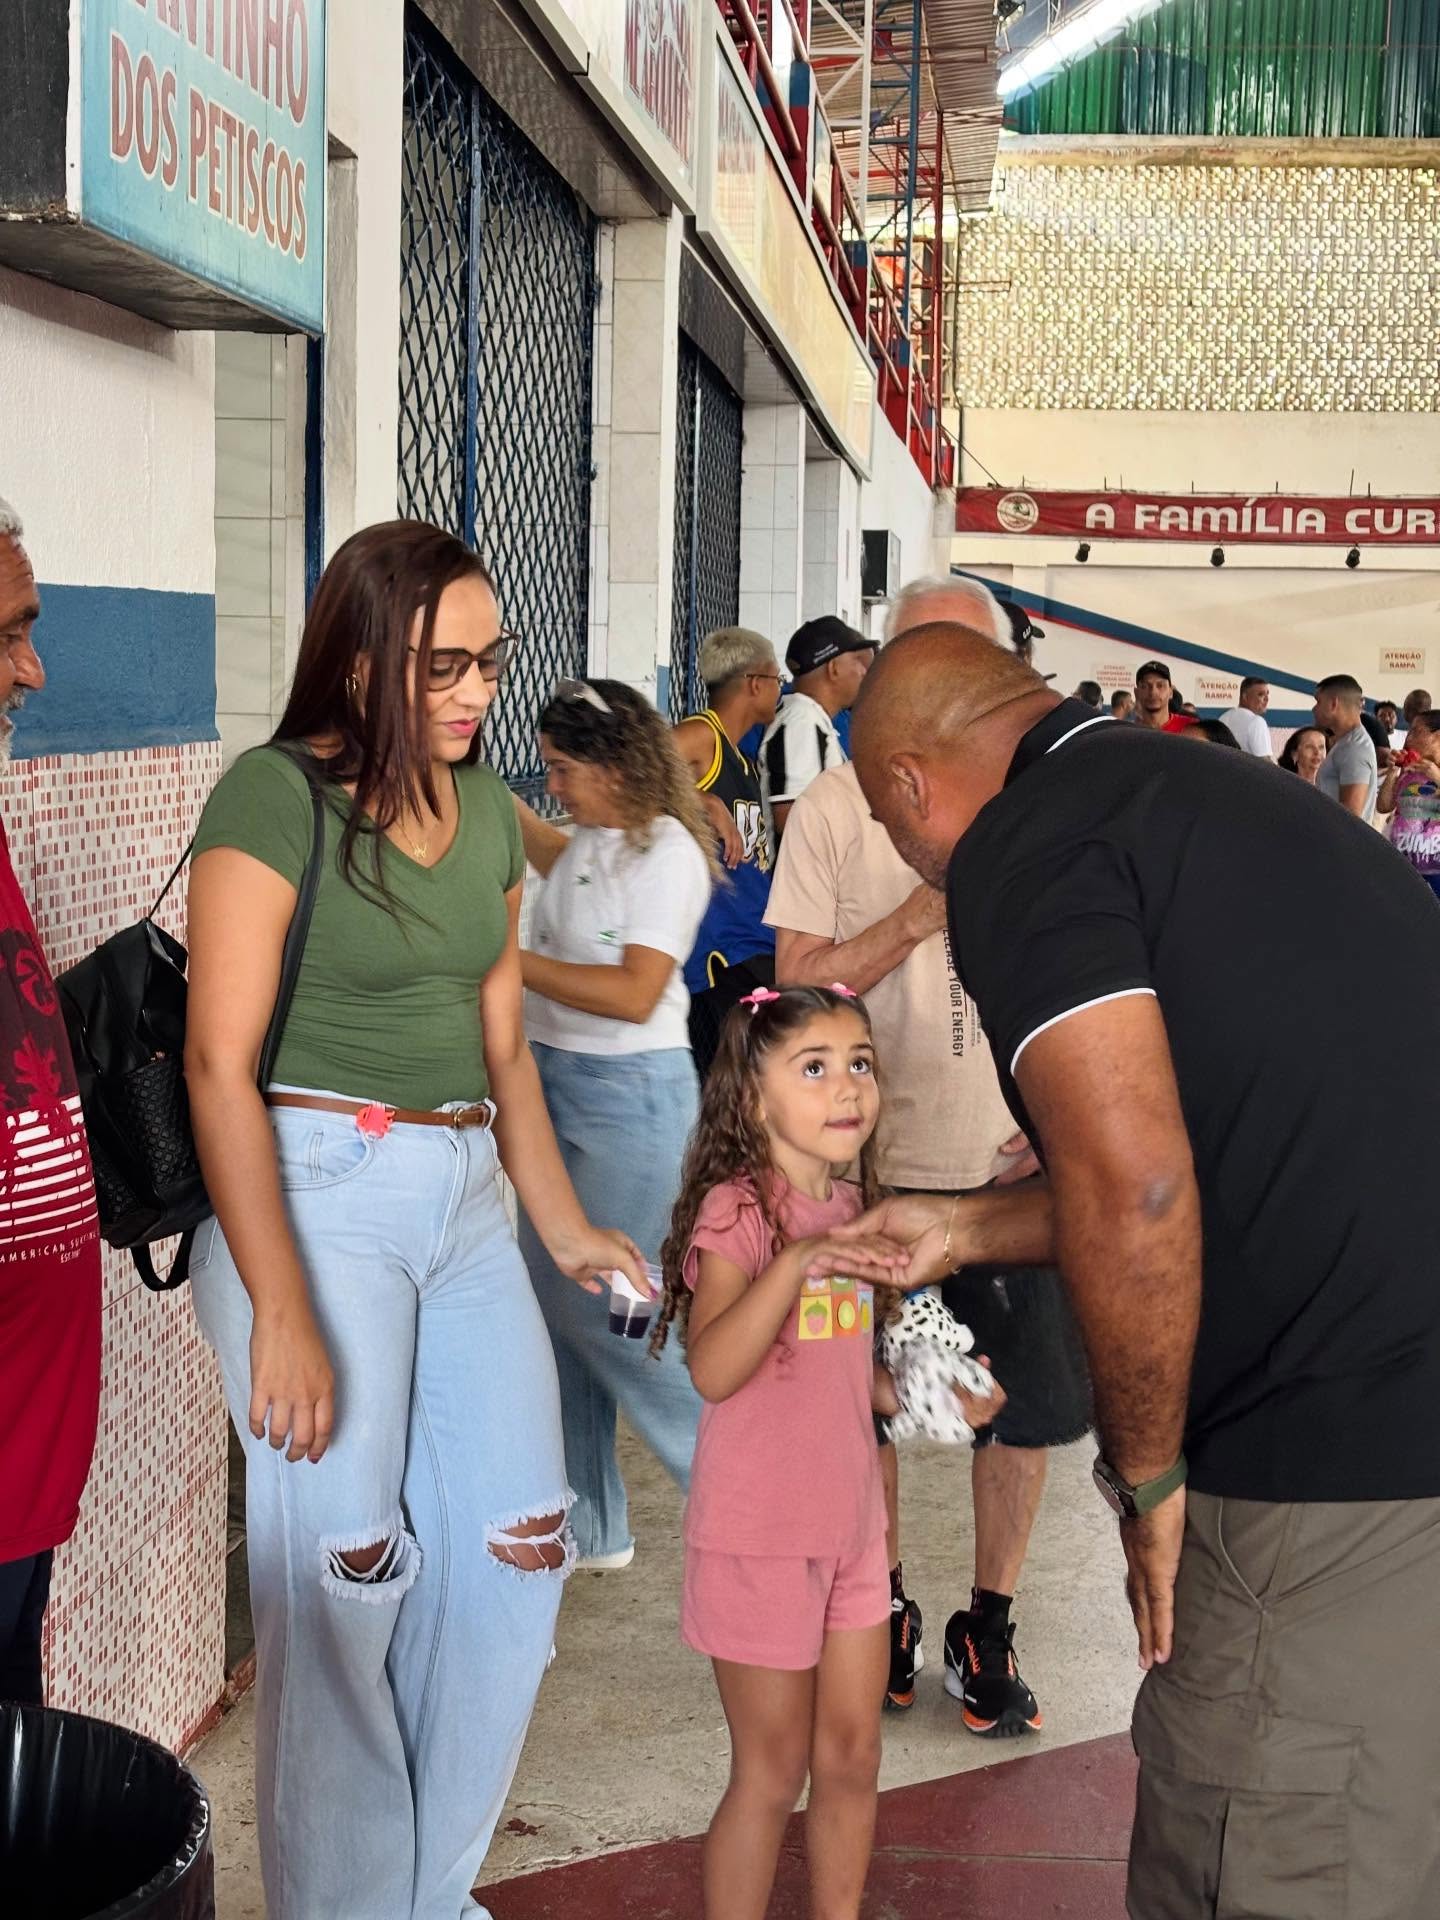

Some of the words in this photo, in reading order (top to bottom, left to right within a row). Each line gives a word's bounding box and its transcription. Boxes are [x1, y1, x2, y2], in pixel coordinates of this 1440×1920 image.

[135, 0, 309, 125] INHO
[111, 32, 179, 189] DOS
[188, 86, 307, 262] PETISCOS
[1085, 502, 1115, 530] A
[1389, 661, 1416, 669] RAMPA
[1205, 691, 1233, 700] RAMPA
[949, 977, 962, 1007] YOUR
[952, 1011, 964, 1057] ENERGY
[0, 1243, 65, 1263] AMERICAN
